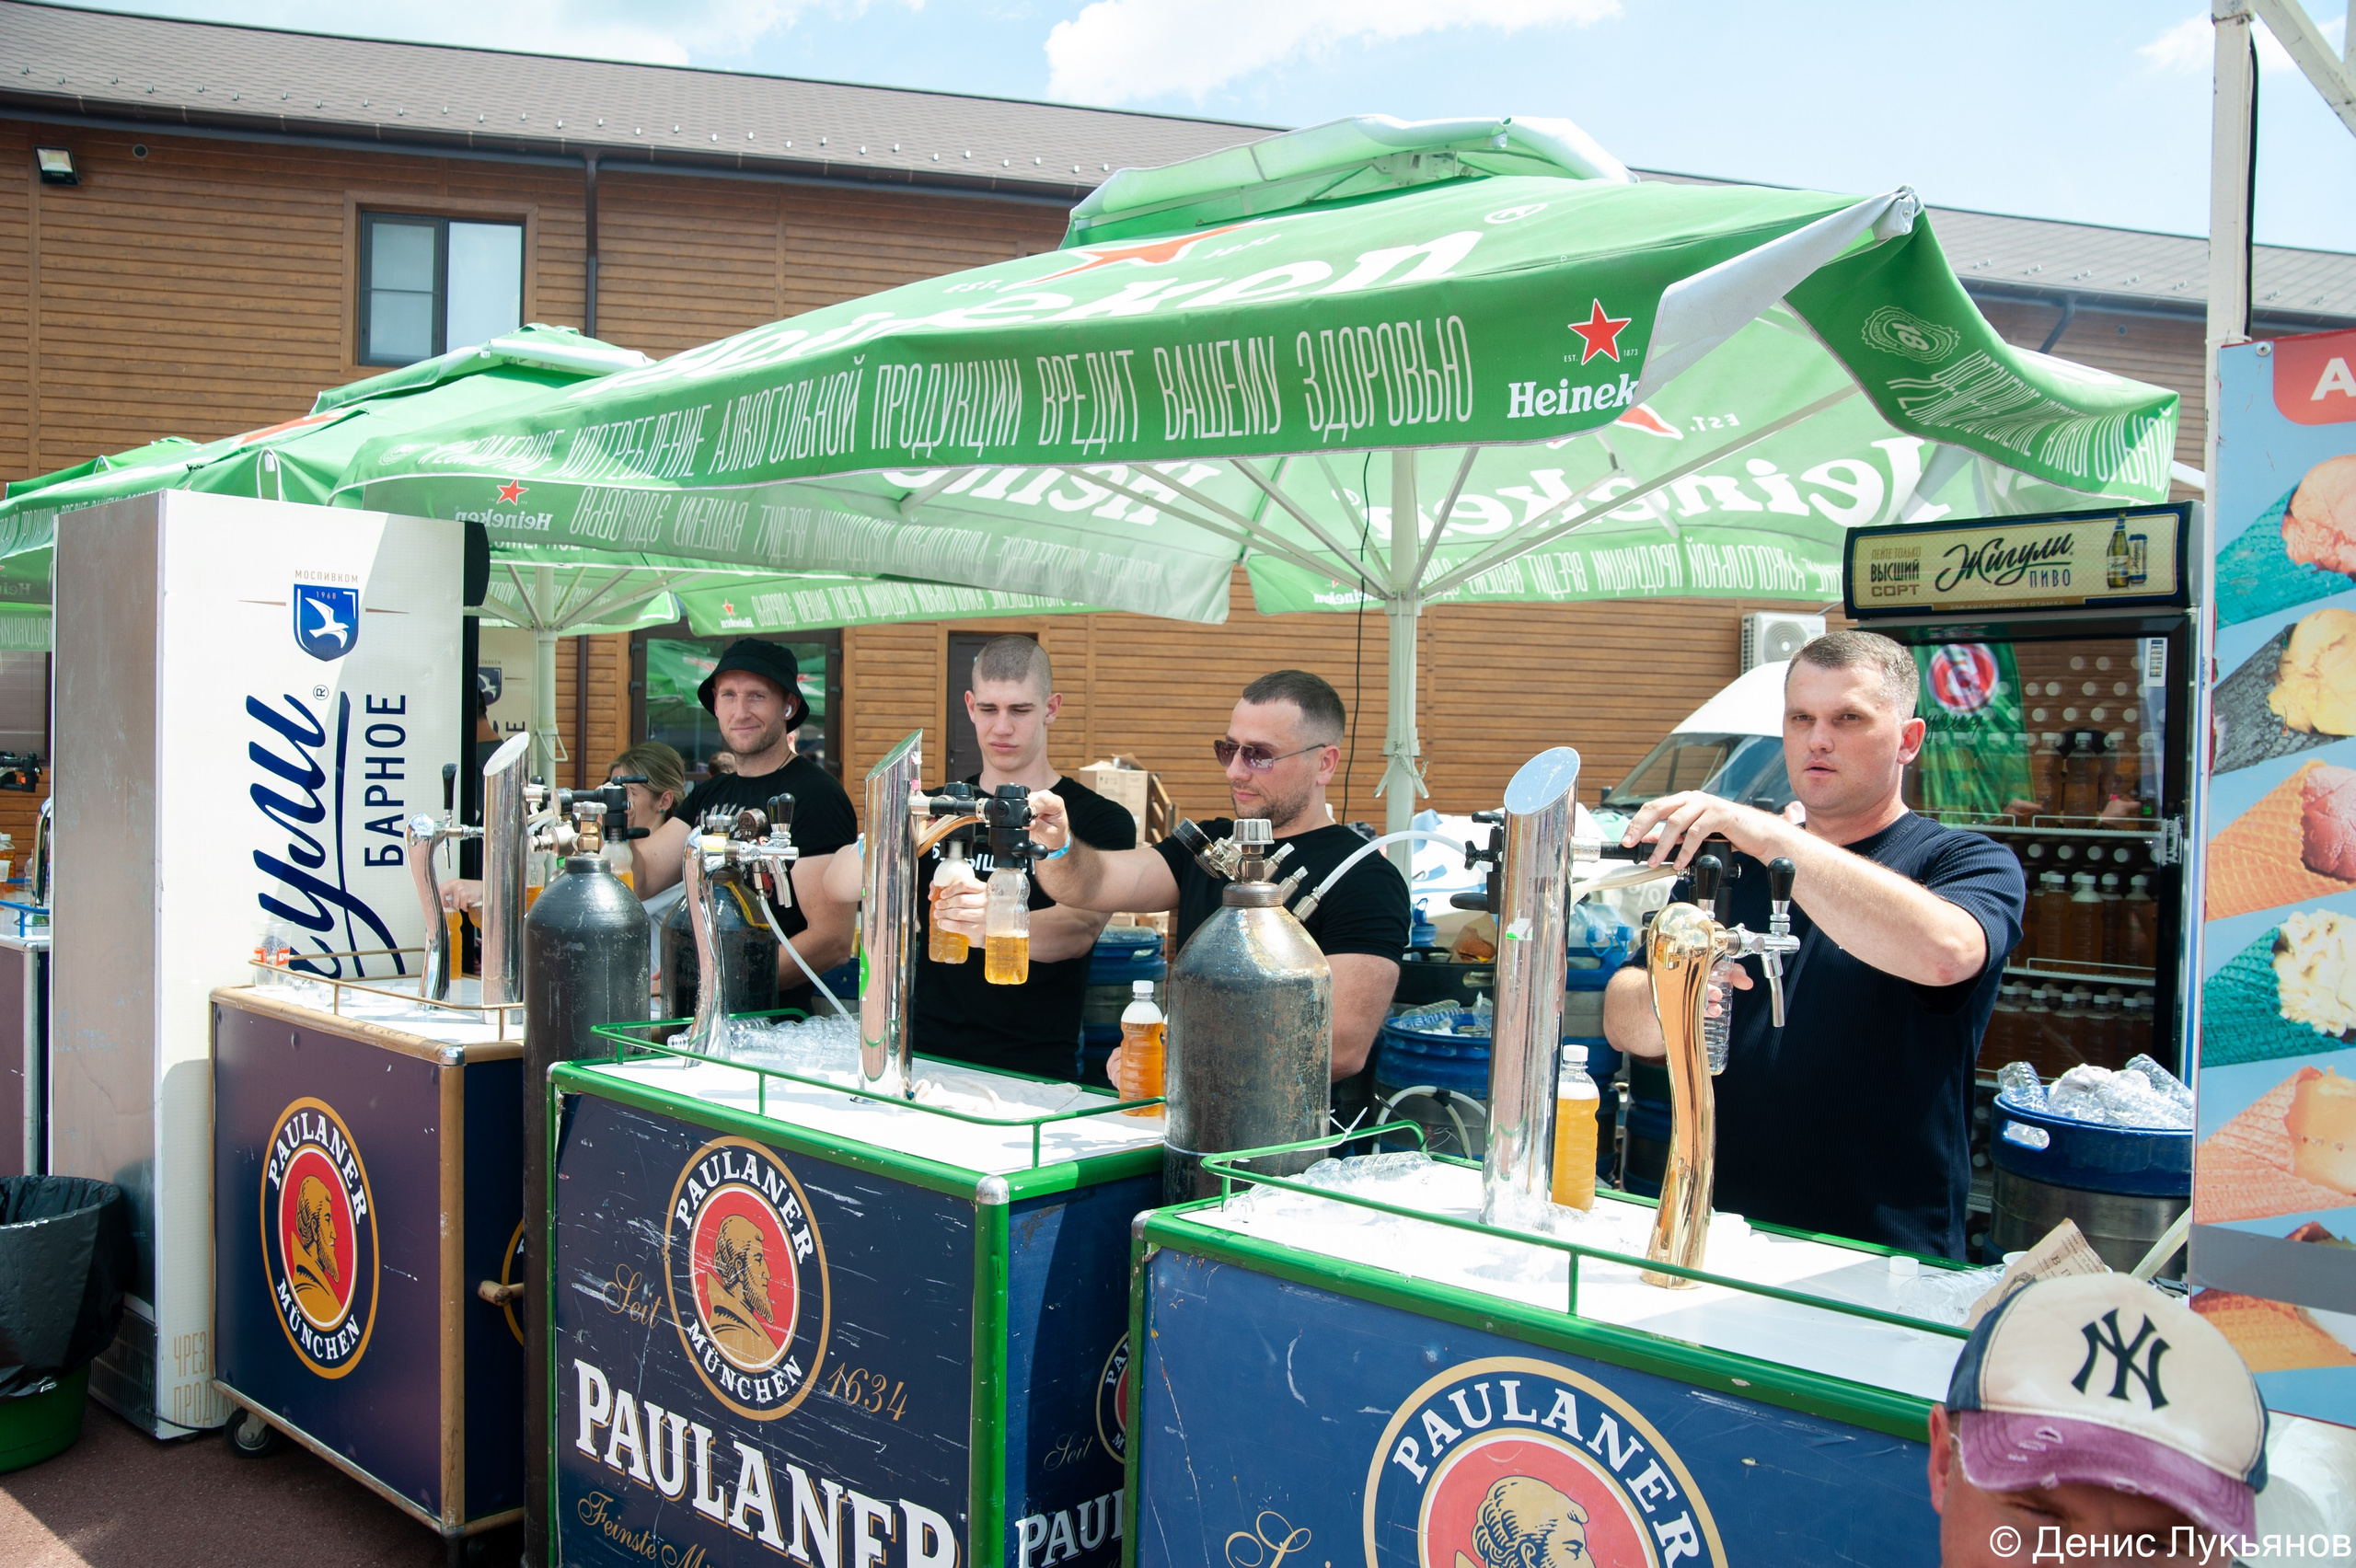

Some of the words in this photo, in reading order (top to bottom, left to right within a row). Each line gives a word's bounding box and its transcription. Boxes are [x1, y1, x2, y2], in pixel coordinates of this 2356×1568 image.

[1623, 348, 1638, 357] 1873
[540, 404, 712, 479] УПОТРЕБЛЕНИЕ
[707, 355, 866, 475] АЛКОГОЛЬНОЙ
[871, 358, 1022, 459] ПРОДУКЦИИ
[1037, 350, 1139, 455] ВРЕДИТ
[1153, 336, 1282, 441] ВАШЕМУ
[1296, 315, 1473, 444] ЗДОРОВЬЮ
[294, 569, 358, 583] МОСПИВКОМ
[1871, 558, 1920, 582] ВЫСШИЙ
[1872, 548, 1894, 560] ПЕЙТЕ
[1894, 545, 1922, 559] ТОЛЬКО
[1934, 532, 2074, 592] Жигули
[2029, 568, 2071, 589] ПИВО
[316, 591, 337, 600] 1968
[1871, 583, 1920, 597] СОРТ
[364, 693, 407, 867] БАРНОЕ
[268, 1113, 367, 1225] PAULANER
[675, 1150, 814, 1264] PAULANER
[276, 1277, 361, 1360] MÜNCHEN
[602, 1262, 665, 1330] Seit
[687, 1318, 804, 1402] MÜNCHEN
[827, 1361, 908, 1422] 1634
[2071, 1308, 2171, 1412] NY
[1044, 1431, 1094, 1472] Seit
[1392, 1379, 1702, 1568] PAULANER
[577, 1490, 658, 1561] Feinste
